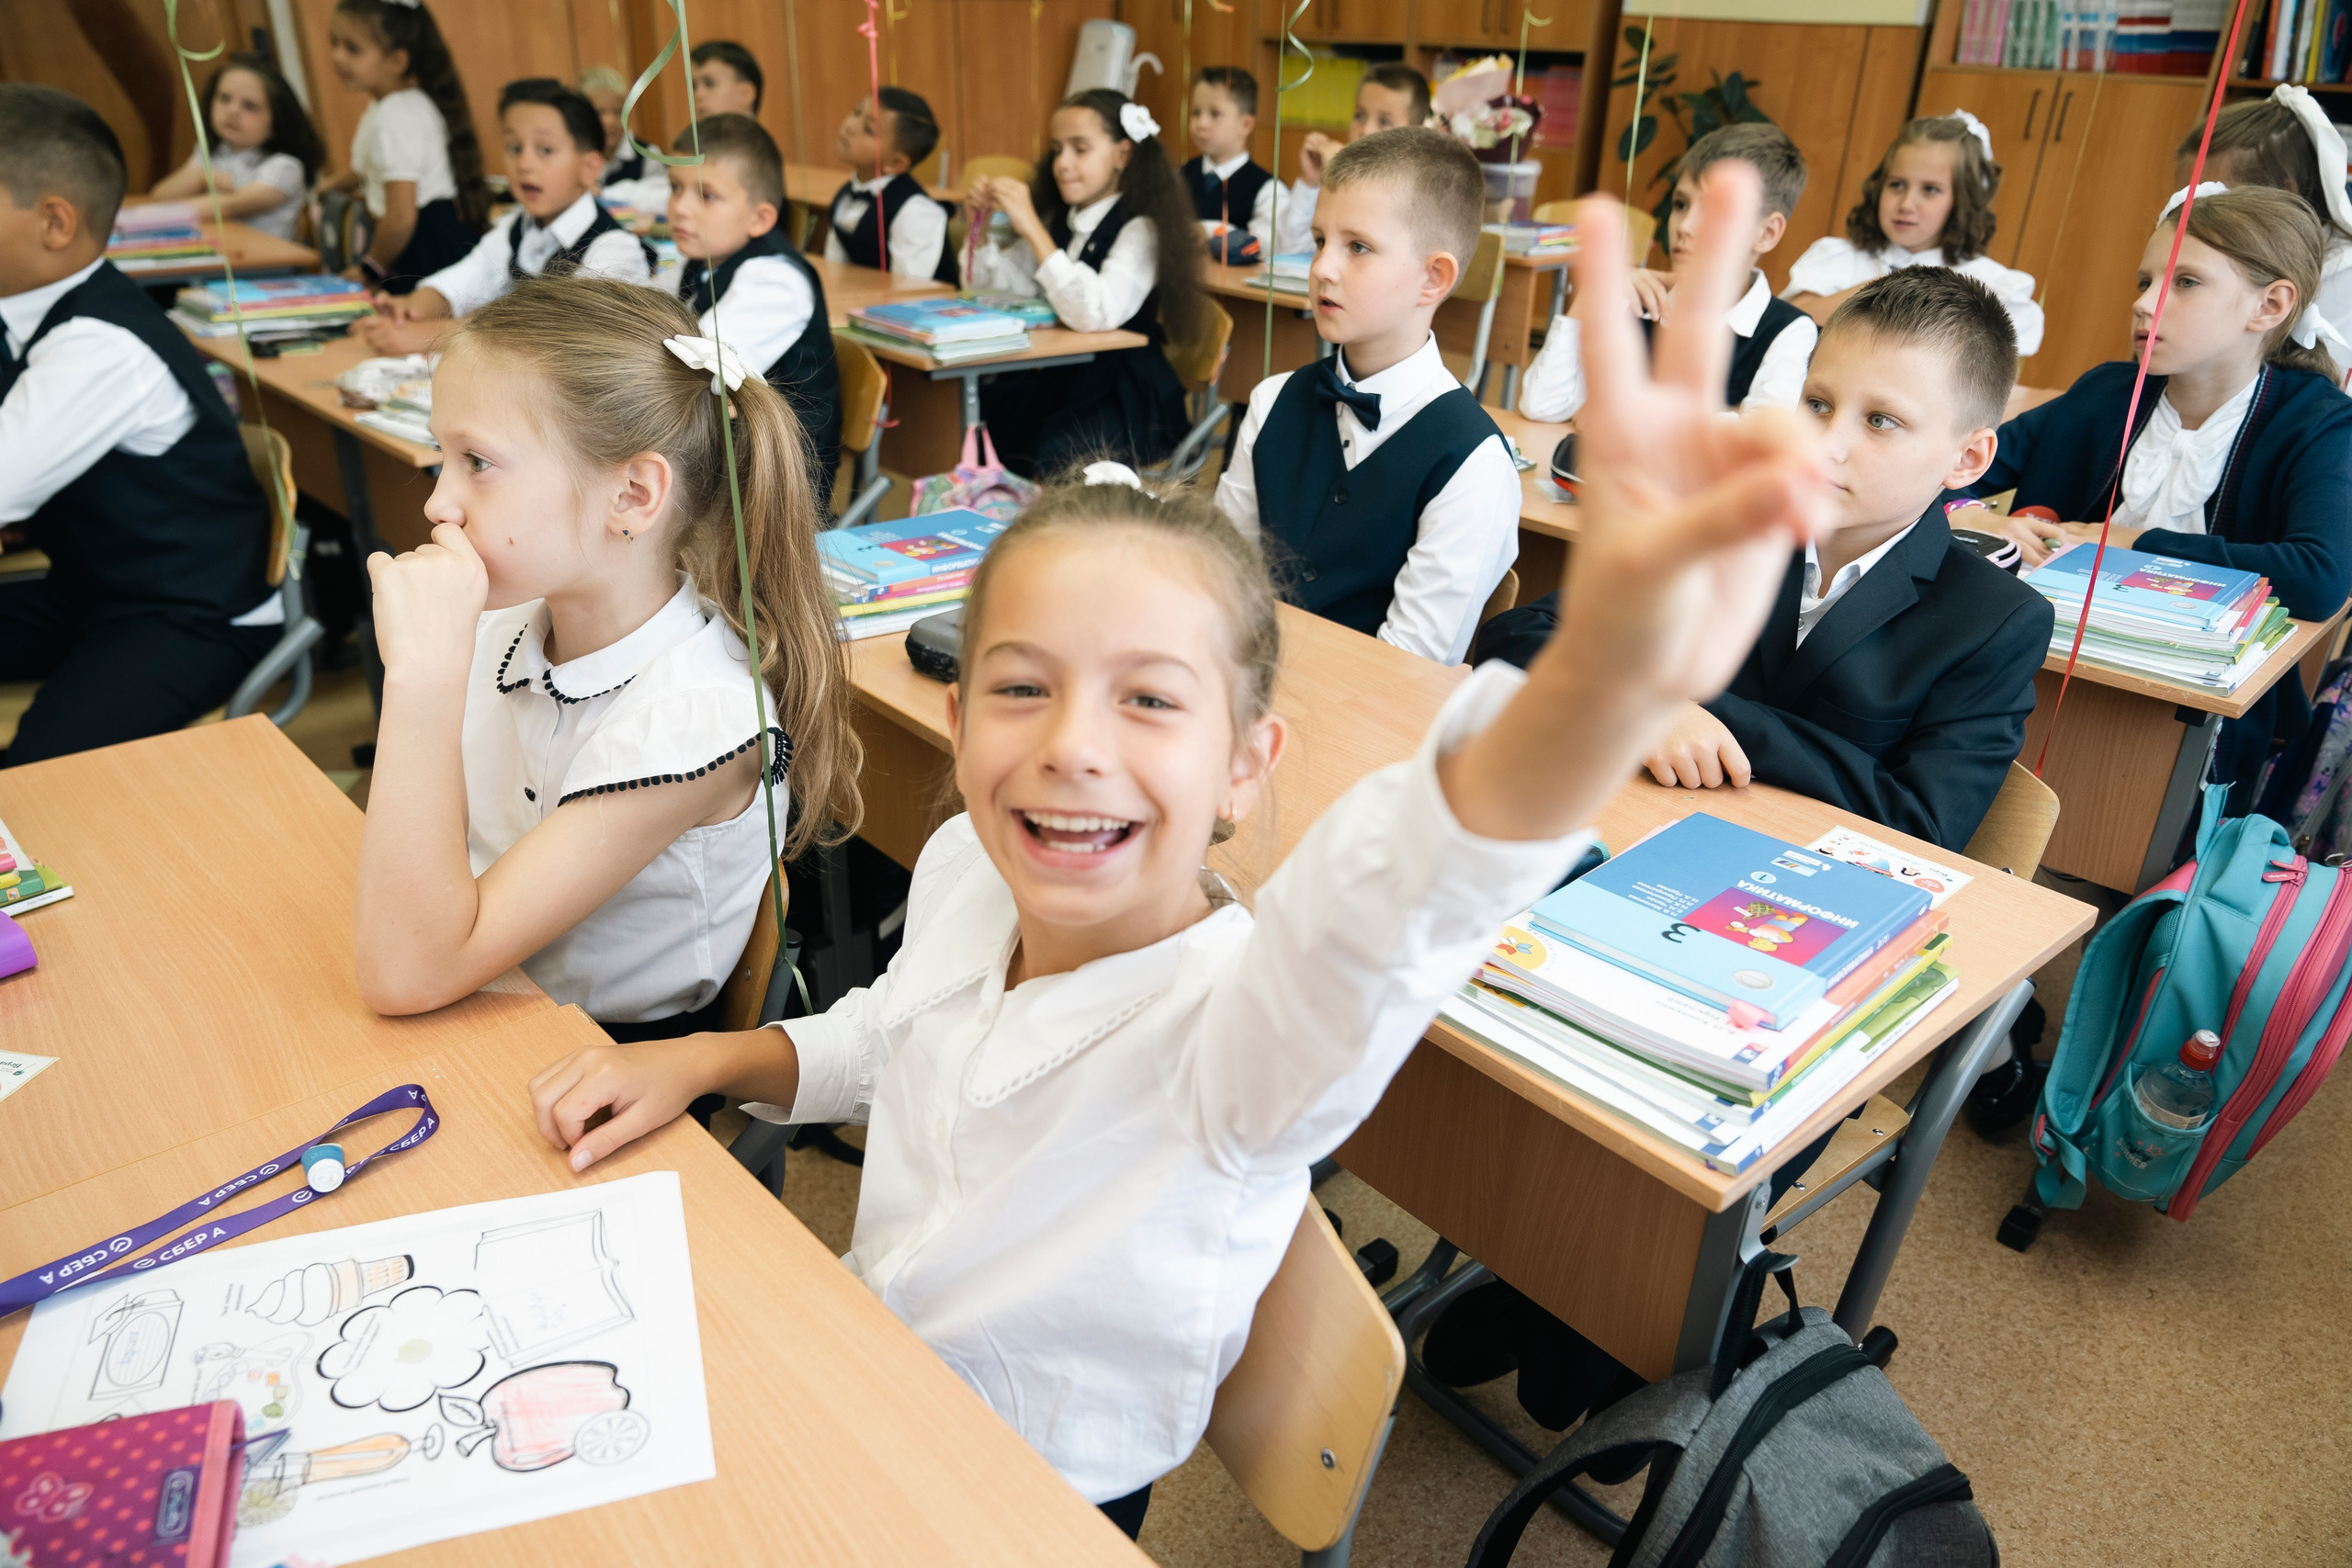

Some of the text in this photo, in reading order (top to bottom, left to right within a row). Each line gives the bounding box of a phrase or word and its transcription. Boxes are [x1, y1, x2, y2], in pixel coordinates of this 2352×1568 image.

[2140, 567, 2227, 588] ИНФОРМАТИКА
[1736, 879, 1860, 929] ИНФОРМАТИКА
[1661, 922, 1702, 943] 3
[390, 1126, 426, 1151] СБЕР
[2116, 1137, 2148, 1169] SUMMER
[215, 1175, 257, 1198] СБЕР
[159, 1232, 208, 1261] СБЕР
[59, 1249, 108, 1278] СБЕР
